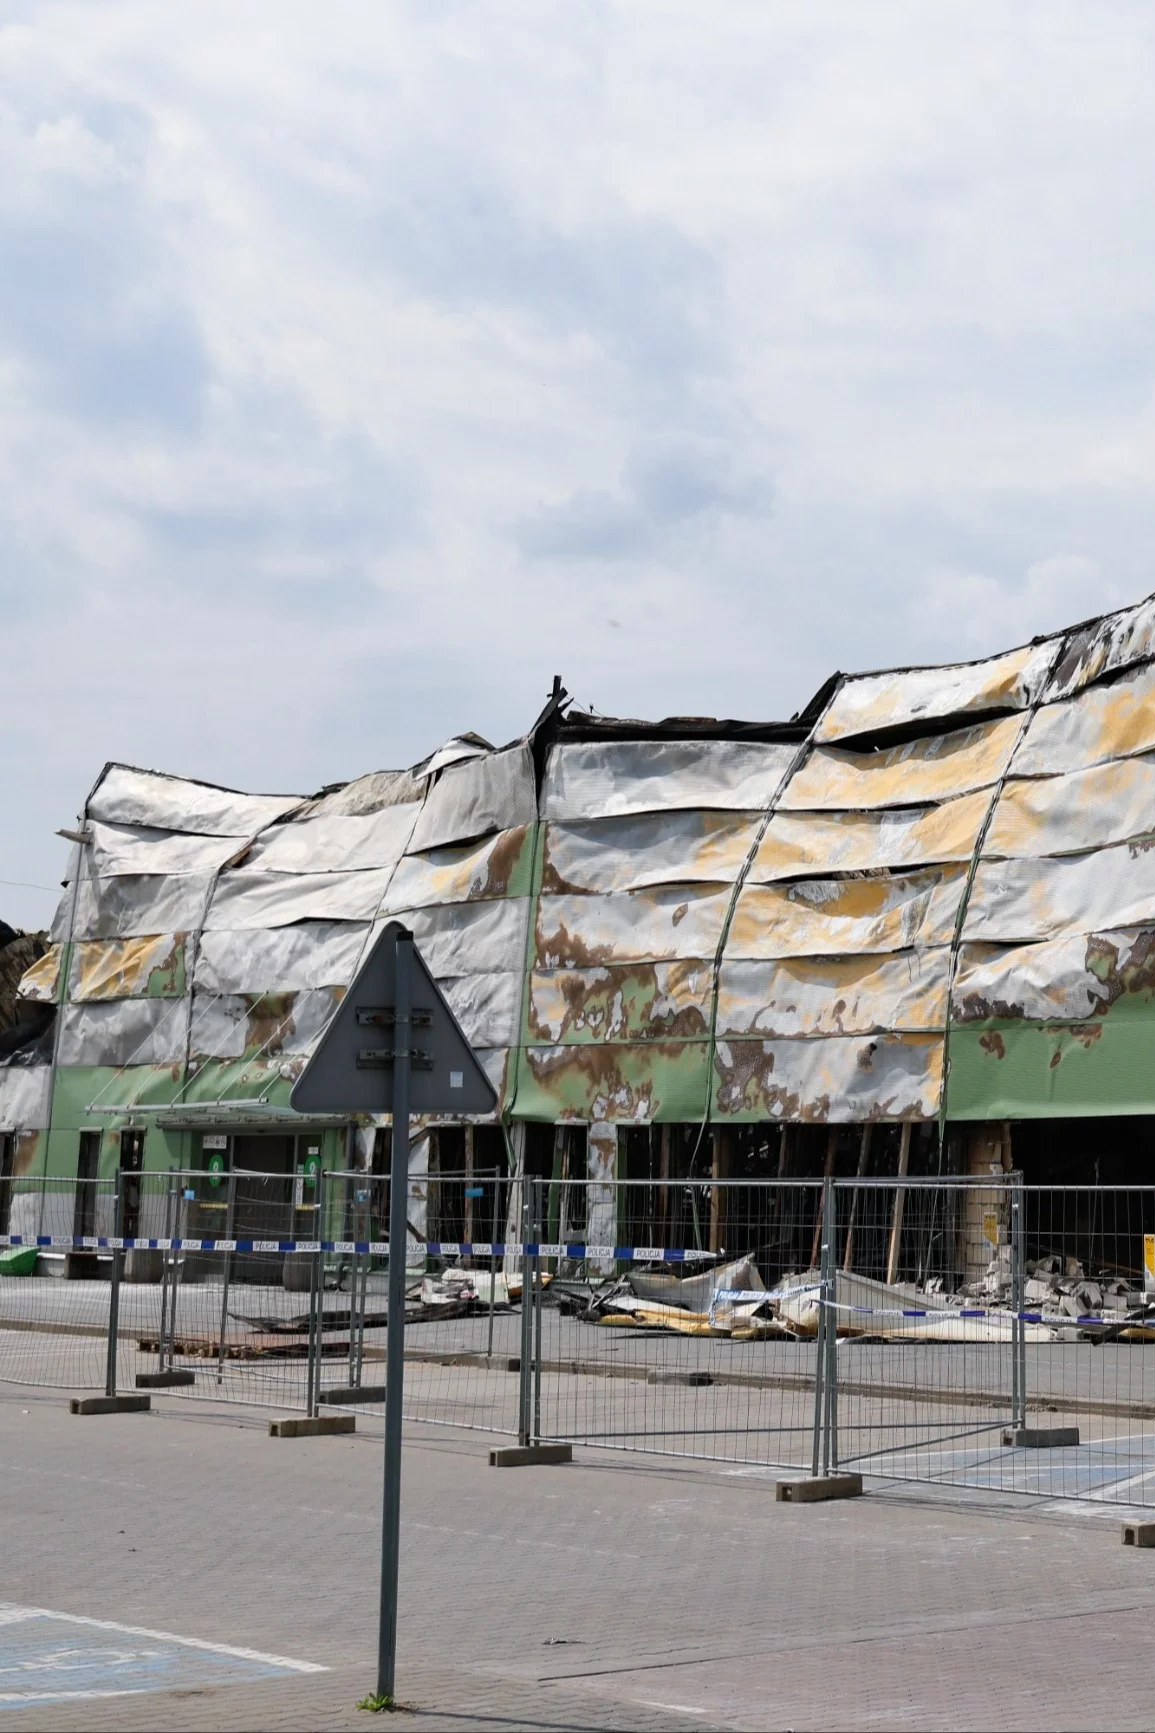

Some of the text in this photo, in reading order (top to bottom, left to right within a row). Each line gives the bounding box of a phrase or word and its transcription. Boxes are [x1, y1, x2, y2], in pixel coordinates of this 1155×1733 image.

[542, 1247, 565, 1255] POLICJA
[588, 1249, 611, 1257] POLICJA
[637, 1250, 661, 1258] POLICJA
